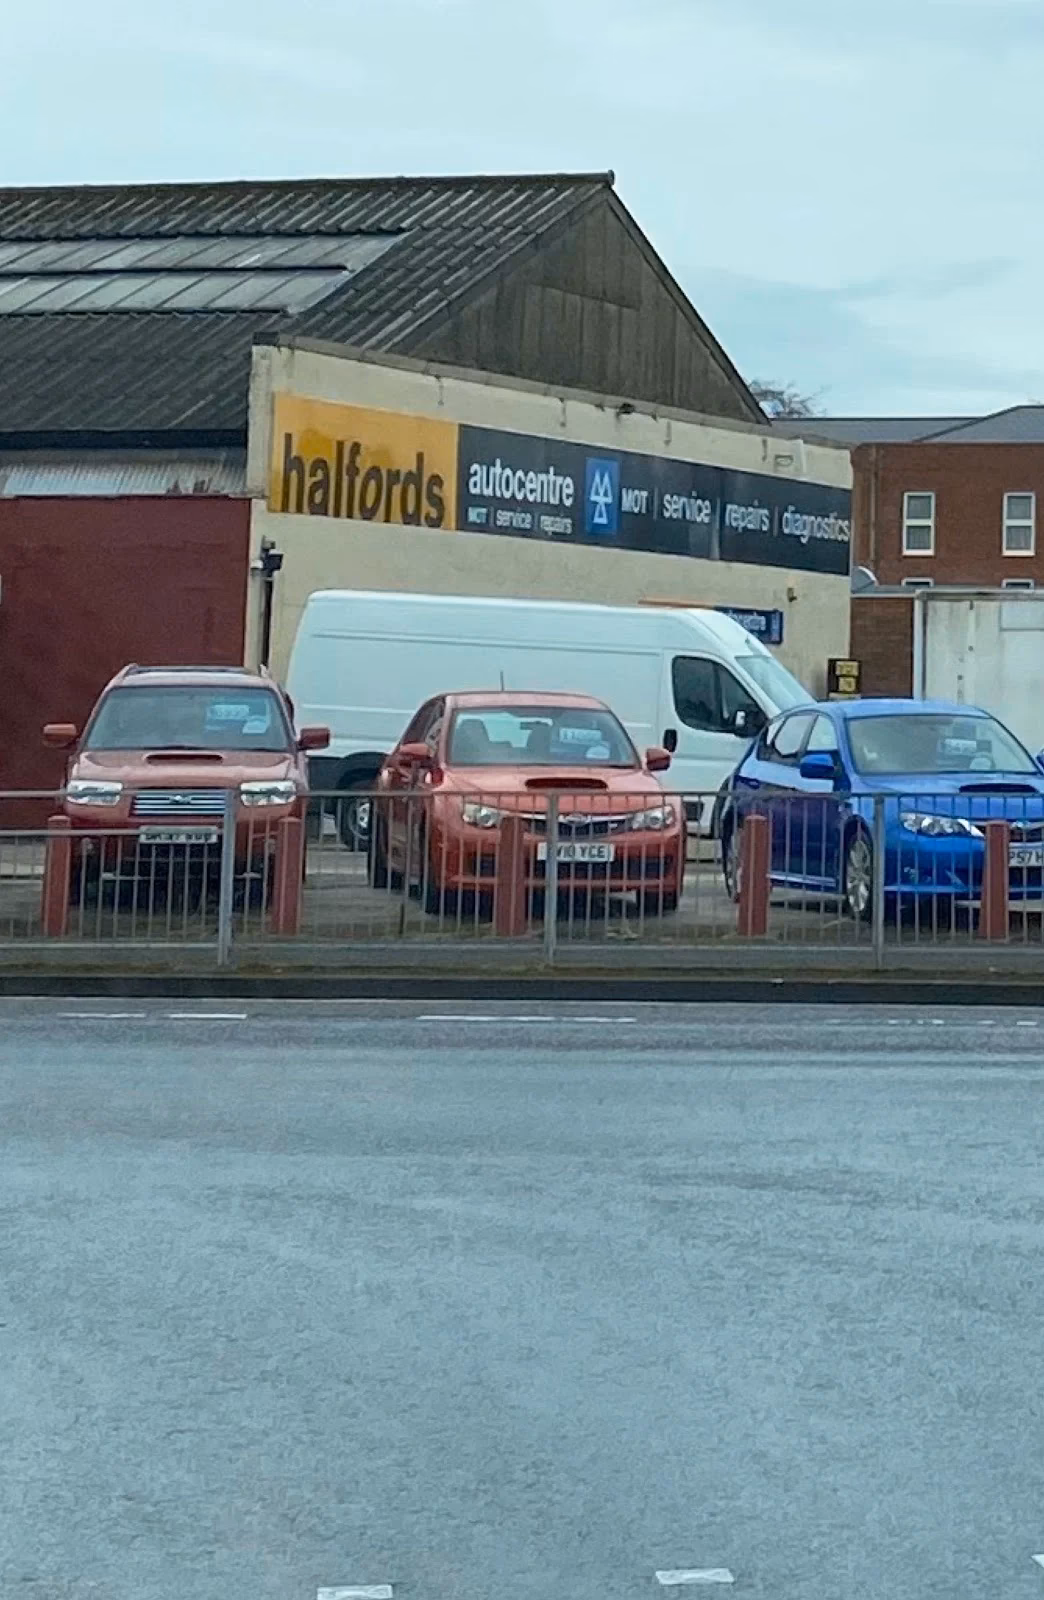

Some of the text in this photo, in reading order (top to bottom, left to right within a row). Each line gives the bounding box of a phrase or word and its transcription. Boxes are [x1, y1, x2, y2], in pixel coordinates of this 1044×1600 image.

[281, 432, 446, 528] halfords
[468, 457, 575, 507] autocentre
[496, 507, 533, 530] service
[540, 512, 573, 536] repairs
[621, 487, 849, 544] MOT service repairs diagnostics
[1008, 850, 1032, 864] P57
